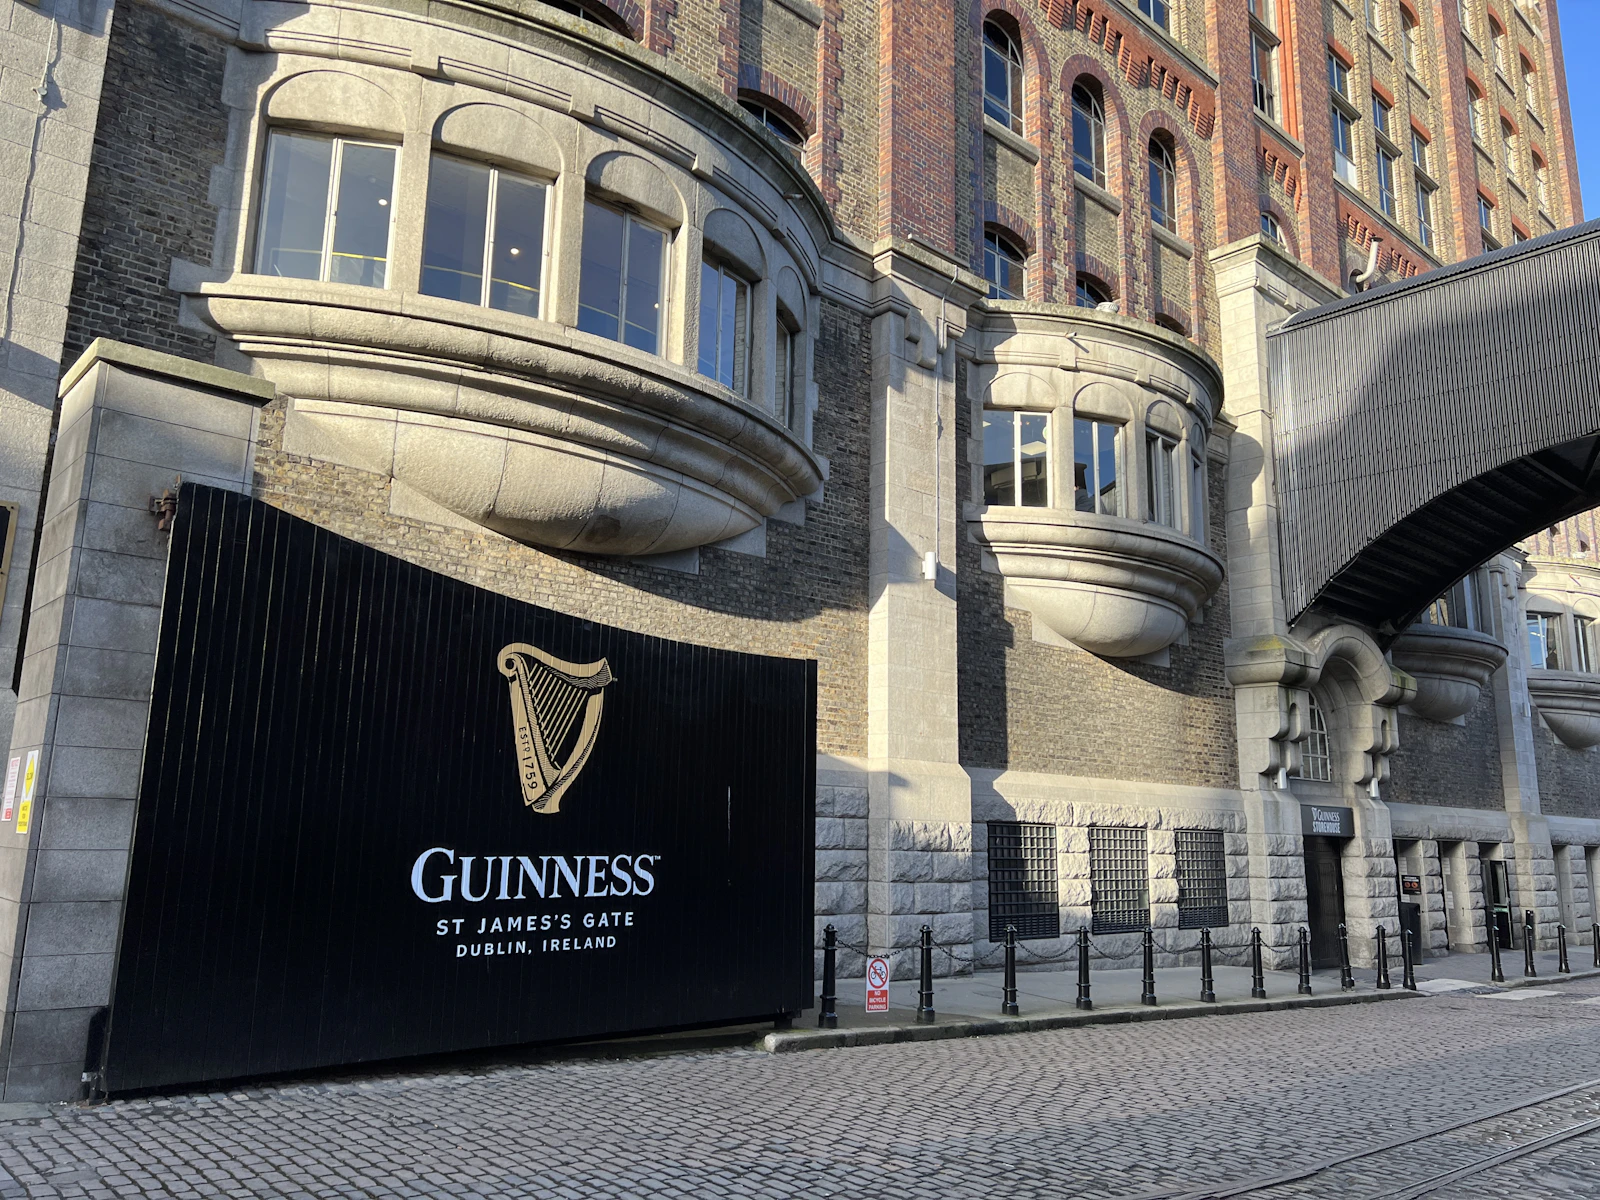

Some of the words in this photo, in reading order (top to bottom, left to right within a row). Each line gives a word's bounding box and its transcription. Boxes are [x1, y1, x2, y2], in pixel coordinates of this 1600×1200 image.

[522, 756, 538, 789] 1759
[1317, 809, 1340, 821] GUINNESS
[1312, 821, 1341, 834] STOREHOUSE
[436, 918, 465, 936] ST
[476, 914, 572, 934] JAMES'S
[582, 911, 635, 928] GATE
[455, 940, 533, 958] DUBLIN,
[542, 935, 617, 951] IRELAND
